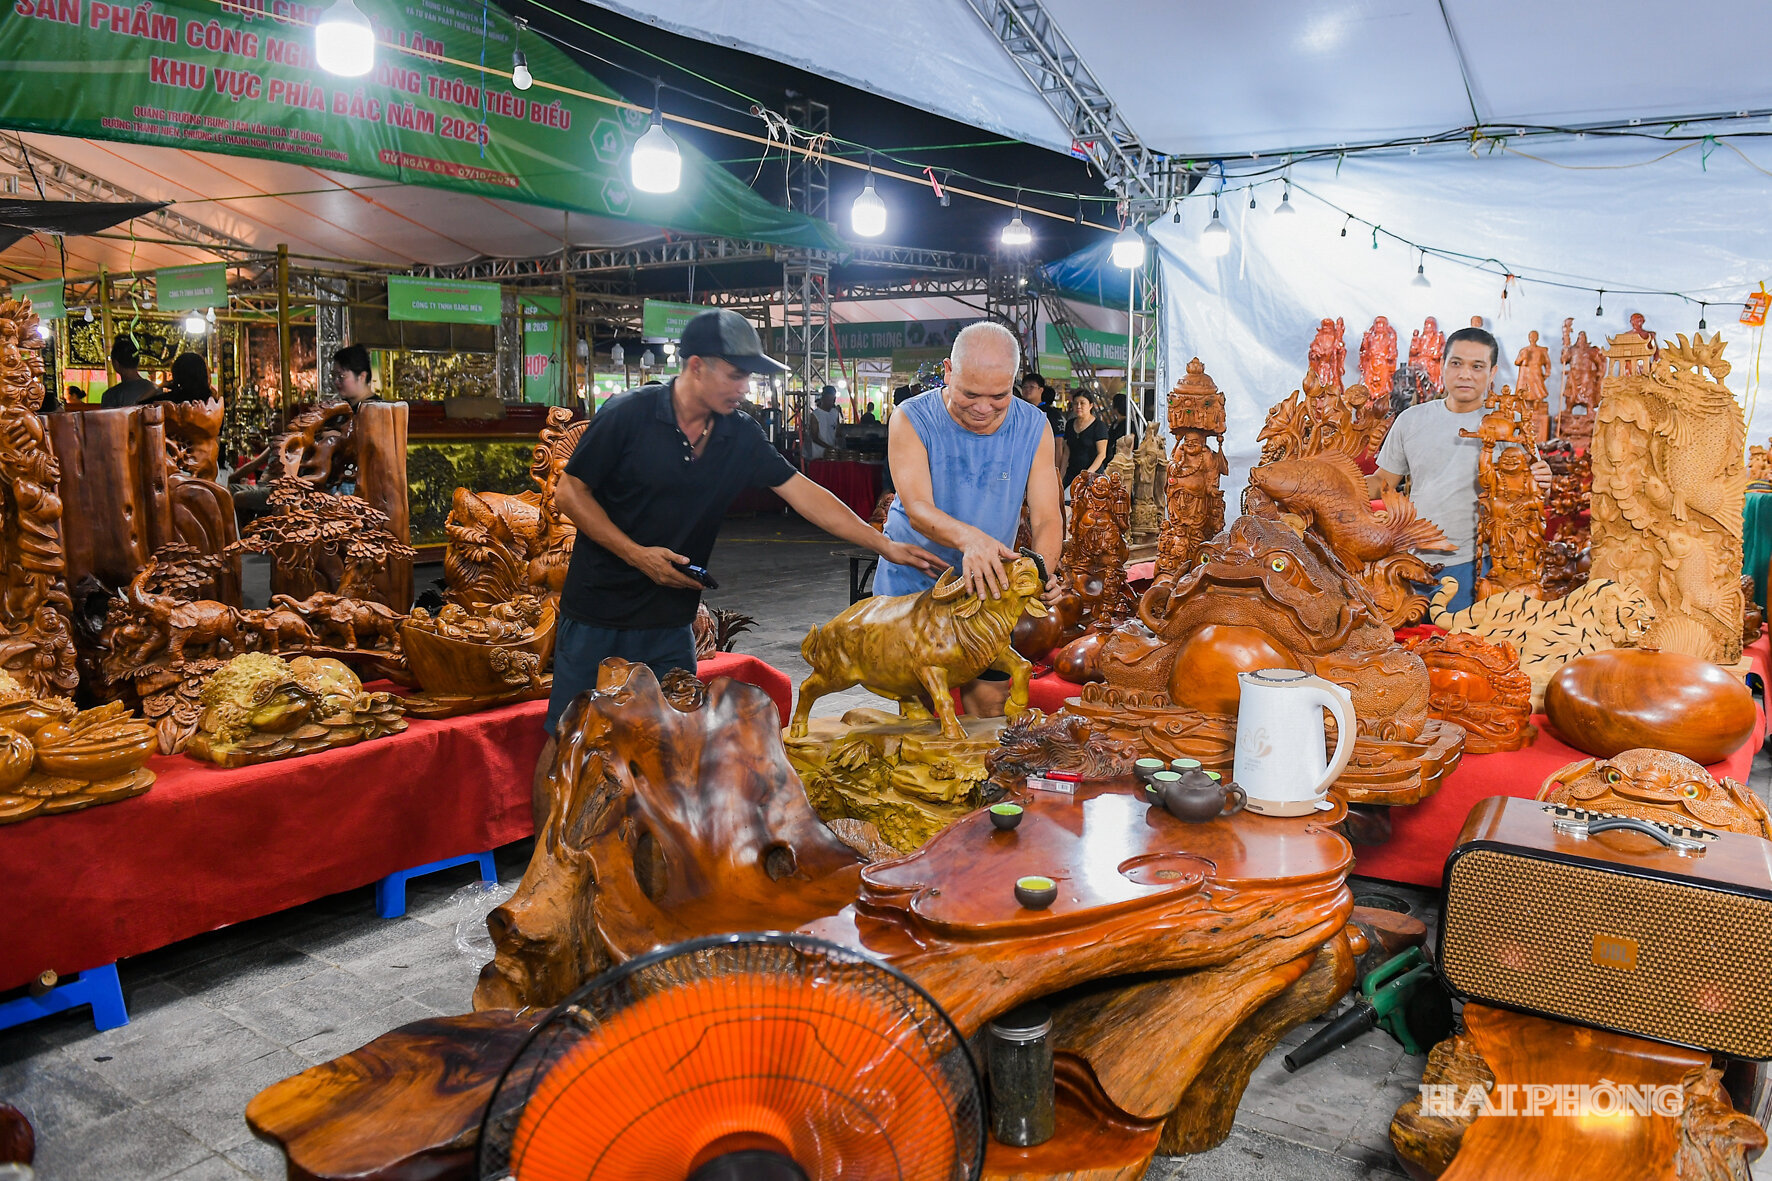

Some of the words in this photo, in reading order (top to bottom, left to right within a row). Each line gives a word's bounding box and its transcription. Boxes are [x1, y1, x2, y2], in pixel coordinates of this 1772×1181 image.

[90, 1, 178, 43] PHẨM
[186, 20, 258, 58] CÔNG
[427, 75, 480, 109] THÔN
[485, 90, 526, 120] TIÊU
[530, 100, 572, 130] BIỂU
[133, 104, 166, 121] QUẢNG
[203, 116, 229, 129] TRUNG
[150, 56, 206, 91] KHU
[214, 67, 262, 103] VỰC
[268, 78, 326, 112] PHÍA
[332, 87, 381, 122] BẮC
[386, 101, 435, 134] NĂM
[440, 116, 490, 146] 2026
[1103, 343, 1129, 364] NGHIỆ
